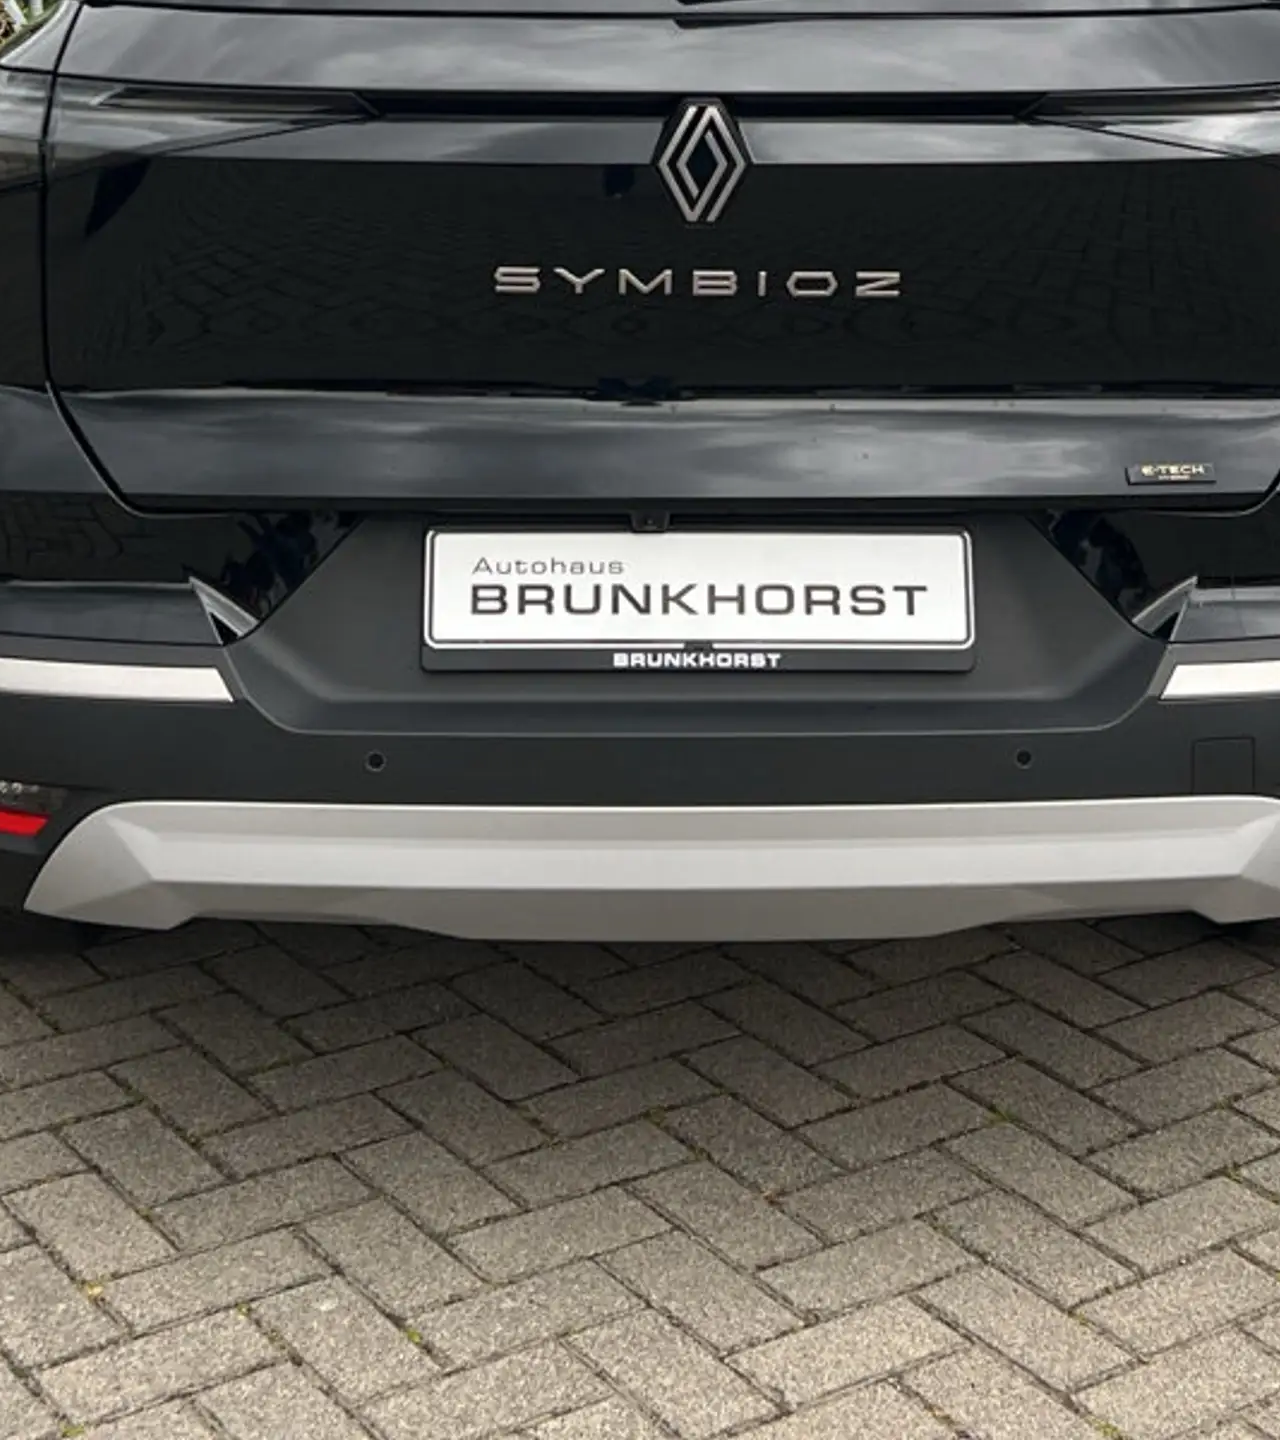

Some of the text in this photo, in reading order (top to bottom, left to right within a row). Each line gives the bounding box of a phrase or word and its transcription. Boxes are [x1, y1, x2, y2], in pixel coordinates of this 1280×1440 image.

[494, 266, 902, 297] SYMBIOZ
[471, 556, 624, 575] Autohaus
[471, 583, 928, 616] BRUNKHORST
[613, 652, 781, 669] BRUNKHORST
